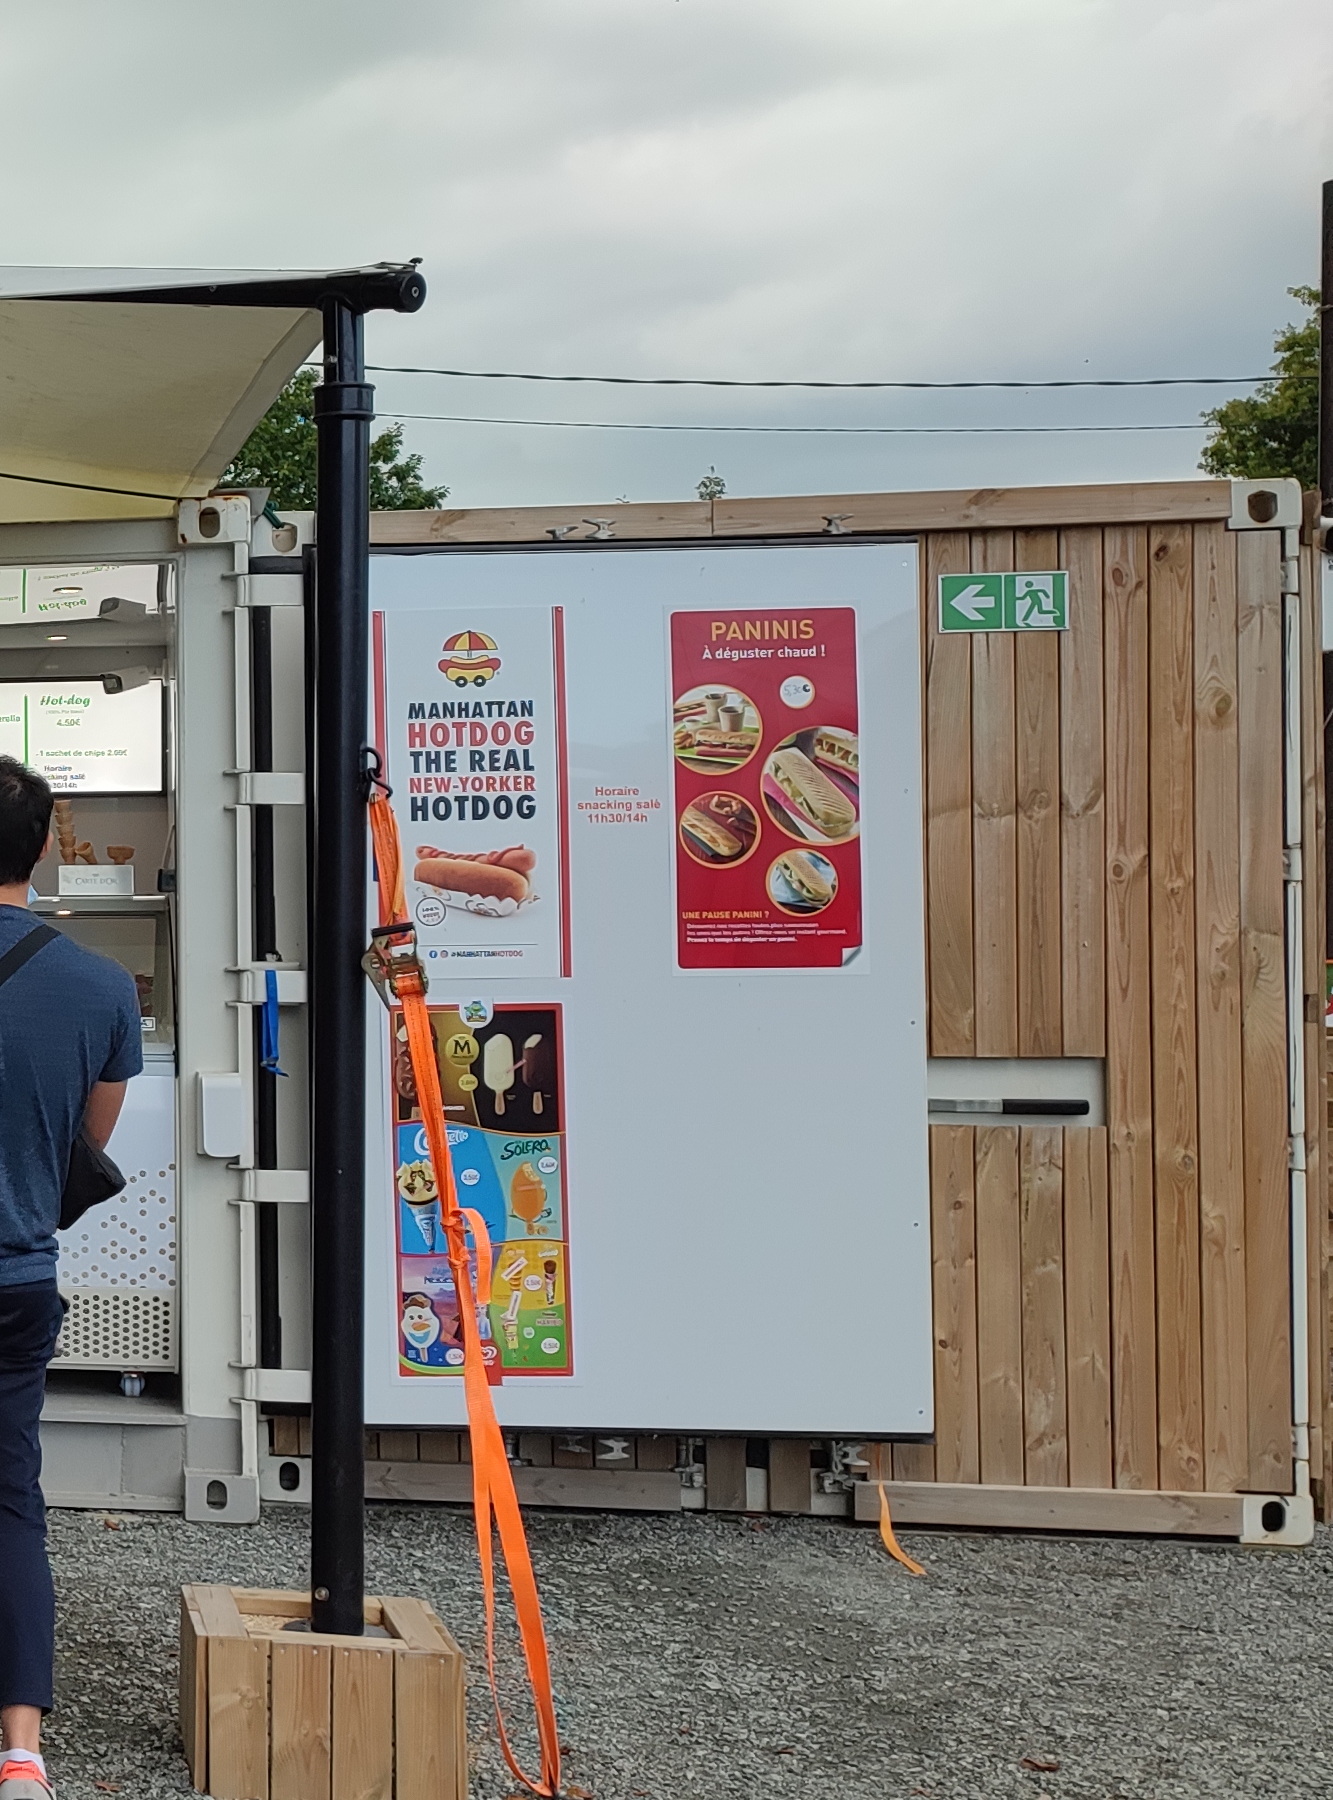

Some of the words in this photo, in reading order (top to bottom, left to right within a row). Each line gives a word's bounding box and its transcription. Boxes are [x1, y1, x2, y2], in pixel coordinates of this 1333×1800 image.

[711, 619, 815, 641] PANINIS
[702, 645, 712, 659] À
[715, 646, 774, 662] déguster
[777, 645, 816, 659] chaud
[40, 695, 90, 707] Hot-dog
[407, 700, 534, 720] MANHATTAN
[407, 721, 535, 748] HOTDOG
[410, 750, 457, 774] THE
[469, 748, 535, 773] REAL
[410, 776, 537, 794] NEW-YORKER
[594, 786, 639, 797] Horaire
[410, 794, 537, 821] HOTDOG
[578, 799, 632, 812] snacking
[637, 798, 661, 810] salé
[587, 812, 648, 824] 11h30/14h
[682, 911, 700, 919] UNE
[702, 911, 731, 919] PAUSE
[733, 910, 763, 918] PANINI
[500, 1139, 548, 1160] SOLERO
